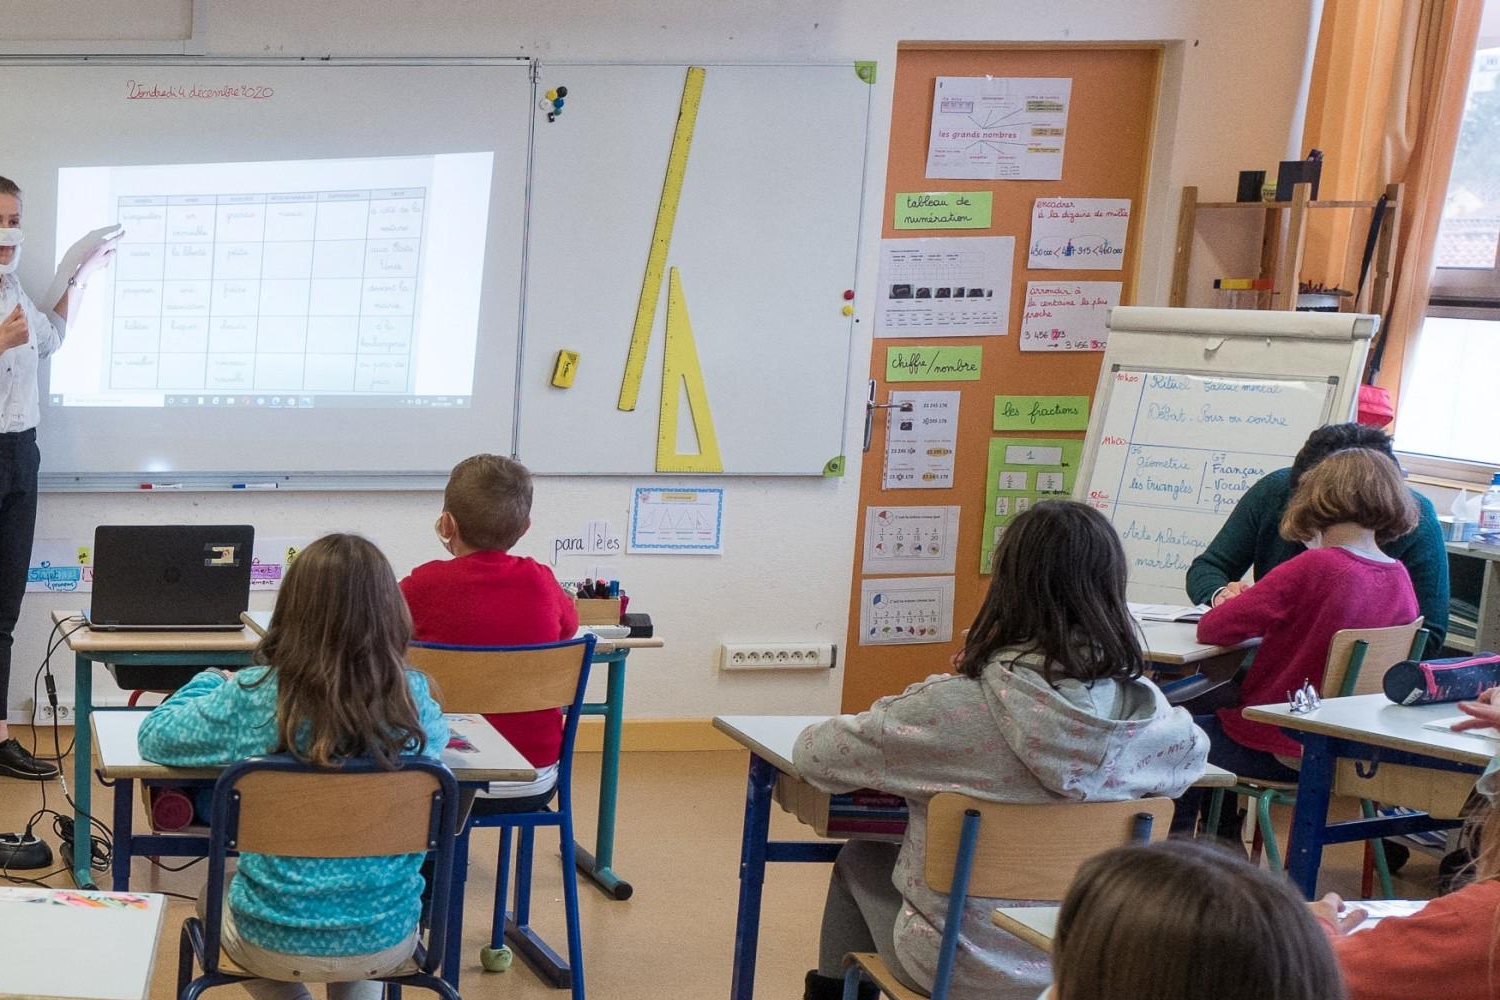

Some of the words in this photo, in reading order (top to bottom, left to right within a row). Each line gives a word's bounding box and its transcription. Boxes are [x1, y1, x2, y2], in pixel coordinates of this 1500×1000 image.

[126, 79, 177, 99] Vendredi
[240, 83, 274, 99] 2020
[952, 131, 980, 140] grands
[982, 131, 1018, 139] nombres
[907, 195, 949, 208] tableau
[956, 196, 972, 206] de
[904, 211, 972, 224] numération
[1001, 401, 1020, 418] les
[1028, 400, 1079, 424] fractions
[1211, 464, 1266, 480] Français
[1129, 477, 1143, 490] les
[1146, 476, 1194, 501] triangles
